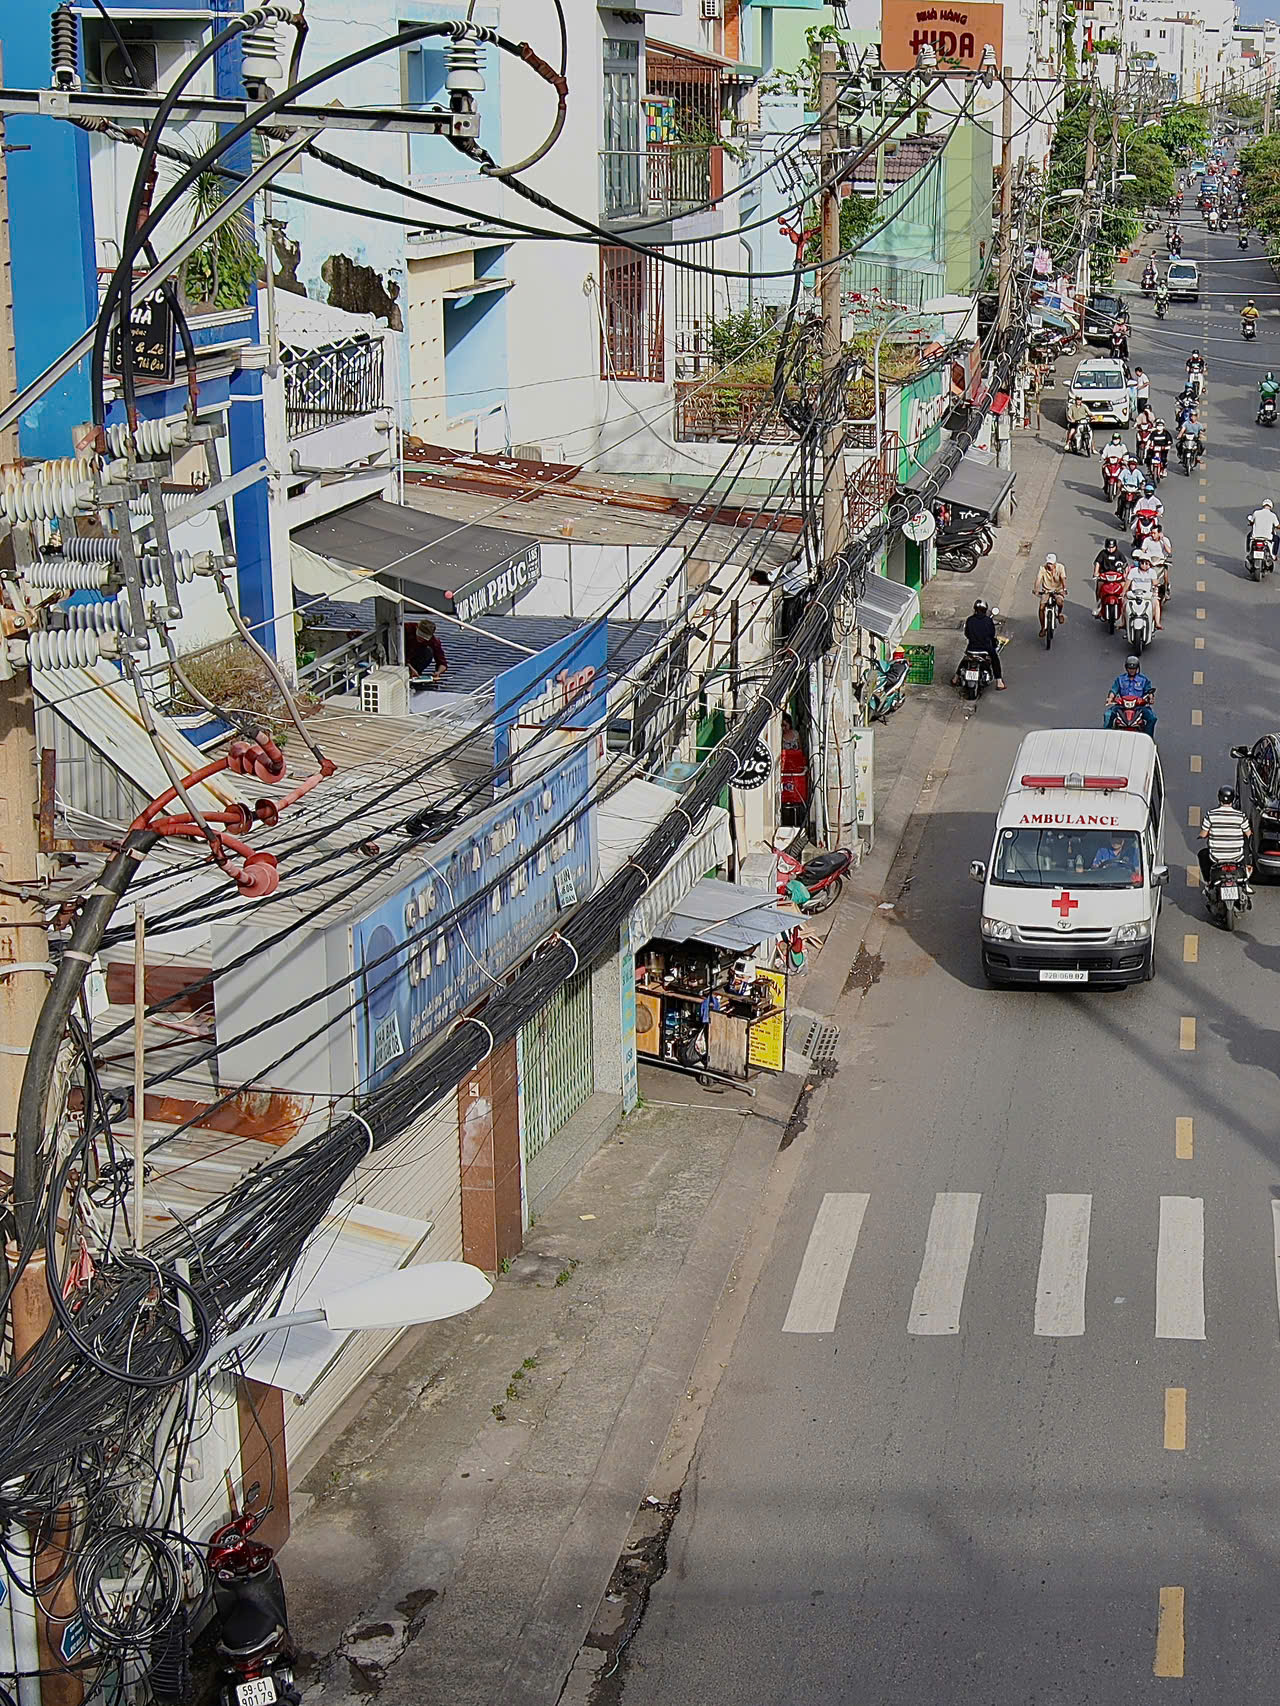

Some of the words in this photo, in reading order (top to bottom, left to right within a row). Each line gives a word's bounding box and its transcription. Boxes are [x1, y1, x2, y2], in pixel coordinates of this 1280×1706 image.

[909, 29, 974, 58] HIDA
[487, 560, 526, 607] PHÚC
[1019, 814, 1120, 826] AMBULANCE
[242, 1681, 267, 1697] 59-C1
